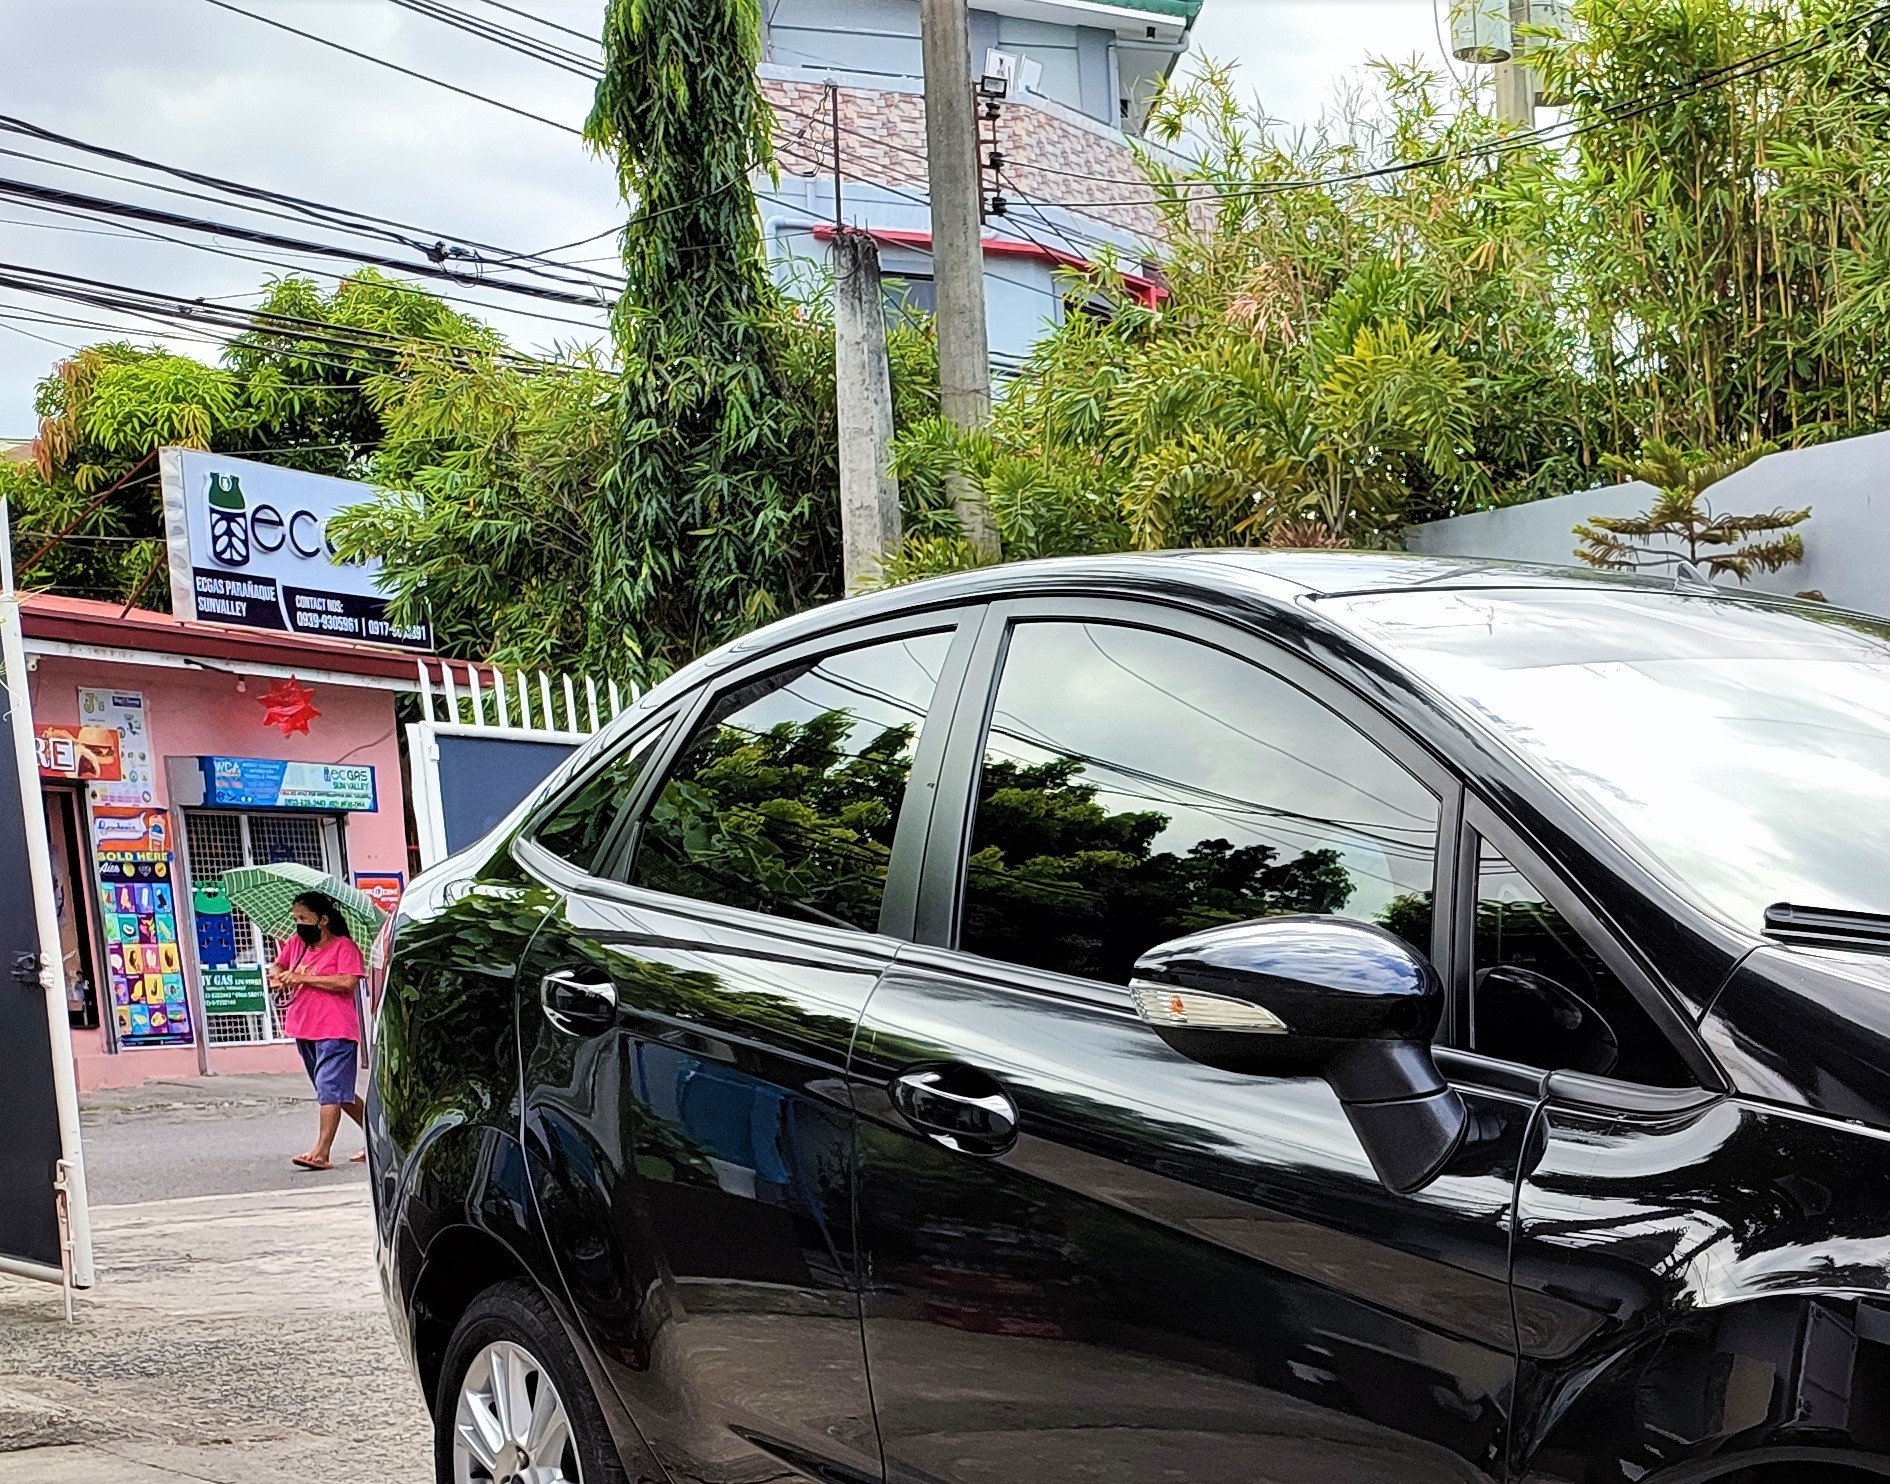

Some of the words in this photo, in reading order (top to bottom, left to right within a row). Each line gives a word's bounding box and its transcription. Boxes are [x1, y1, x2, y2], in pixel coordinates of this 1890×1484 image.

[195, 576, 224, 594] ECGAS
[198, 596, 247, 617] SUNVALLEY
[295, 595, 326, 611] CONTACT
[136, 851, 168, 861] HERE
[213, 974, 234, 986] GAS
